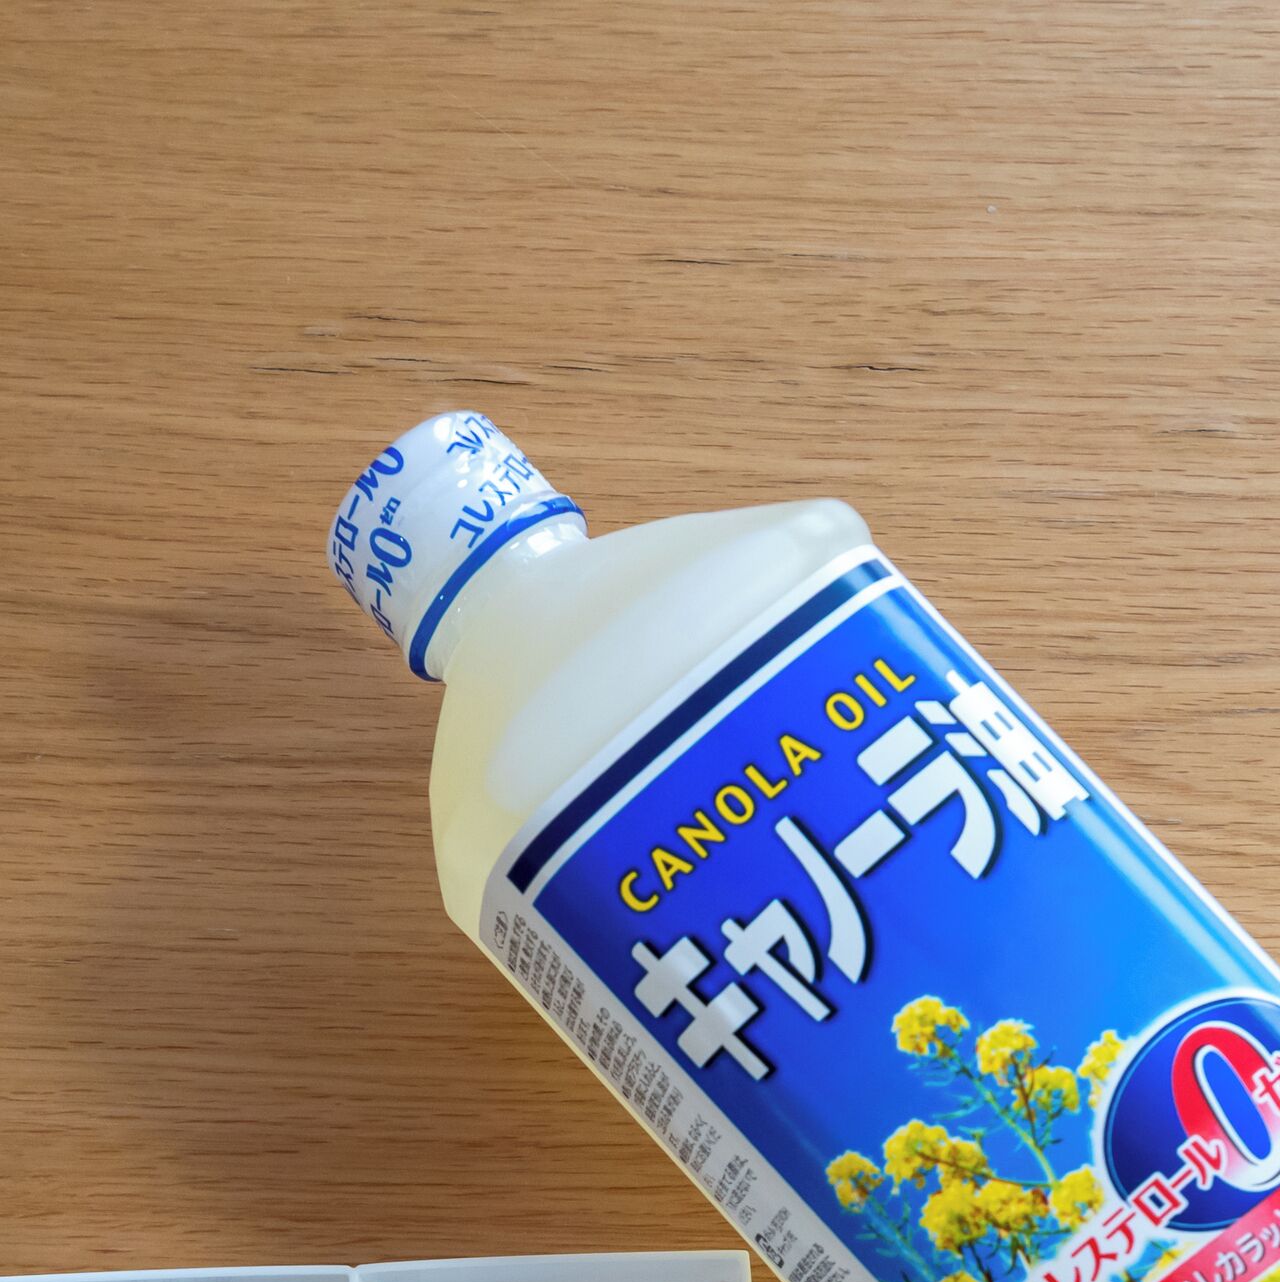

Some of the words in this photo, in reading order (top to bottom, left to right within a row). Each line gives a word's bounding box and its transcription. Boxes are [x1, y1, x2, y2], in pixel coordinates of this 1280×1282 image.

[619, 733, 822, 912] CANOLA
[824, 658, 917, 731] OIL
[631, 669, 1091, 1082] キャノーラ油
